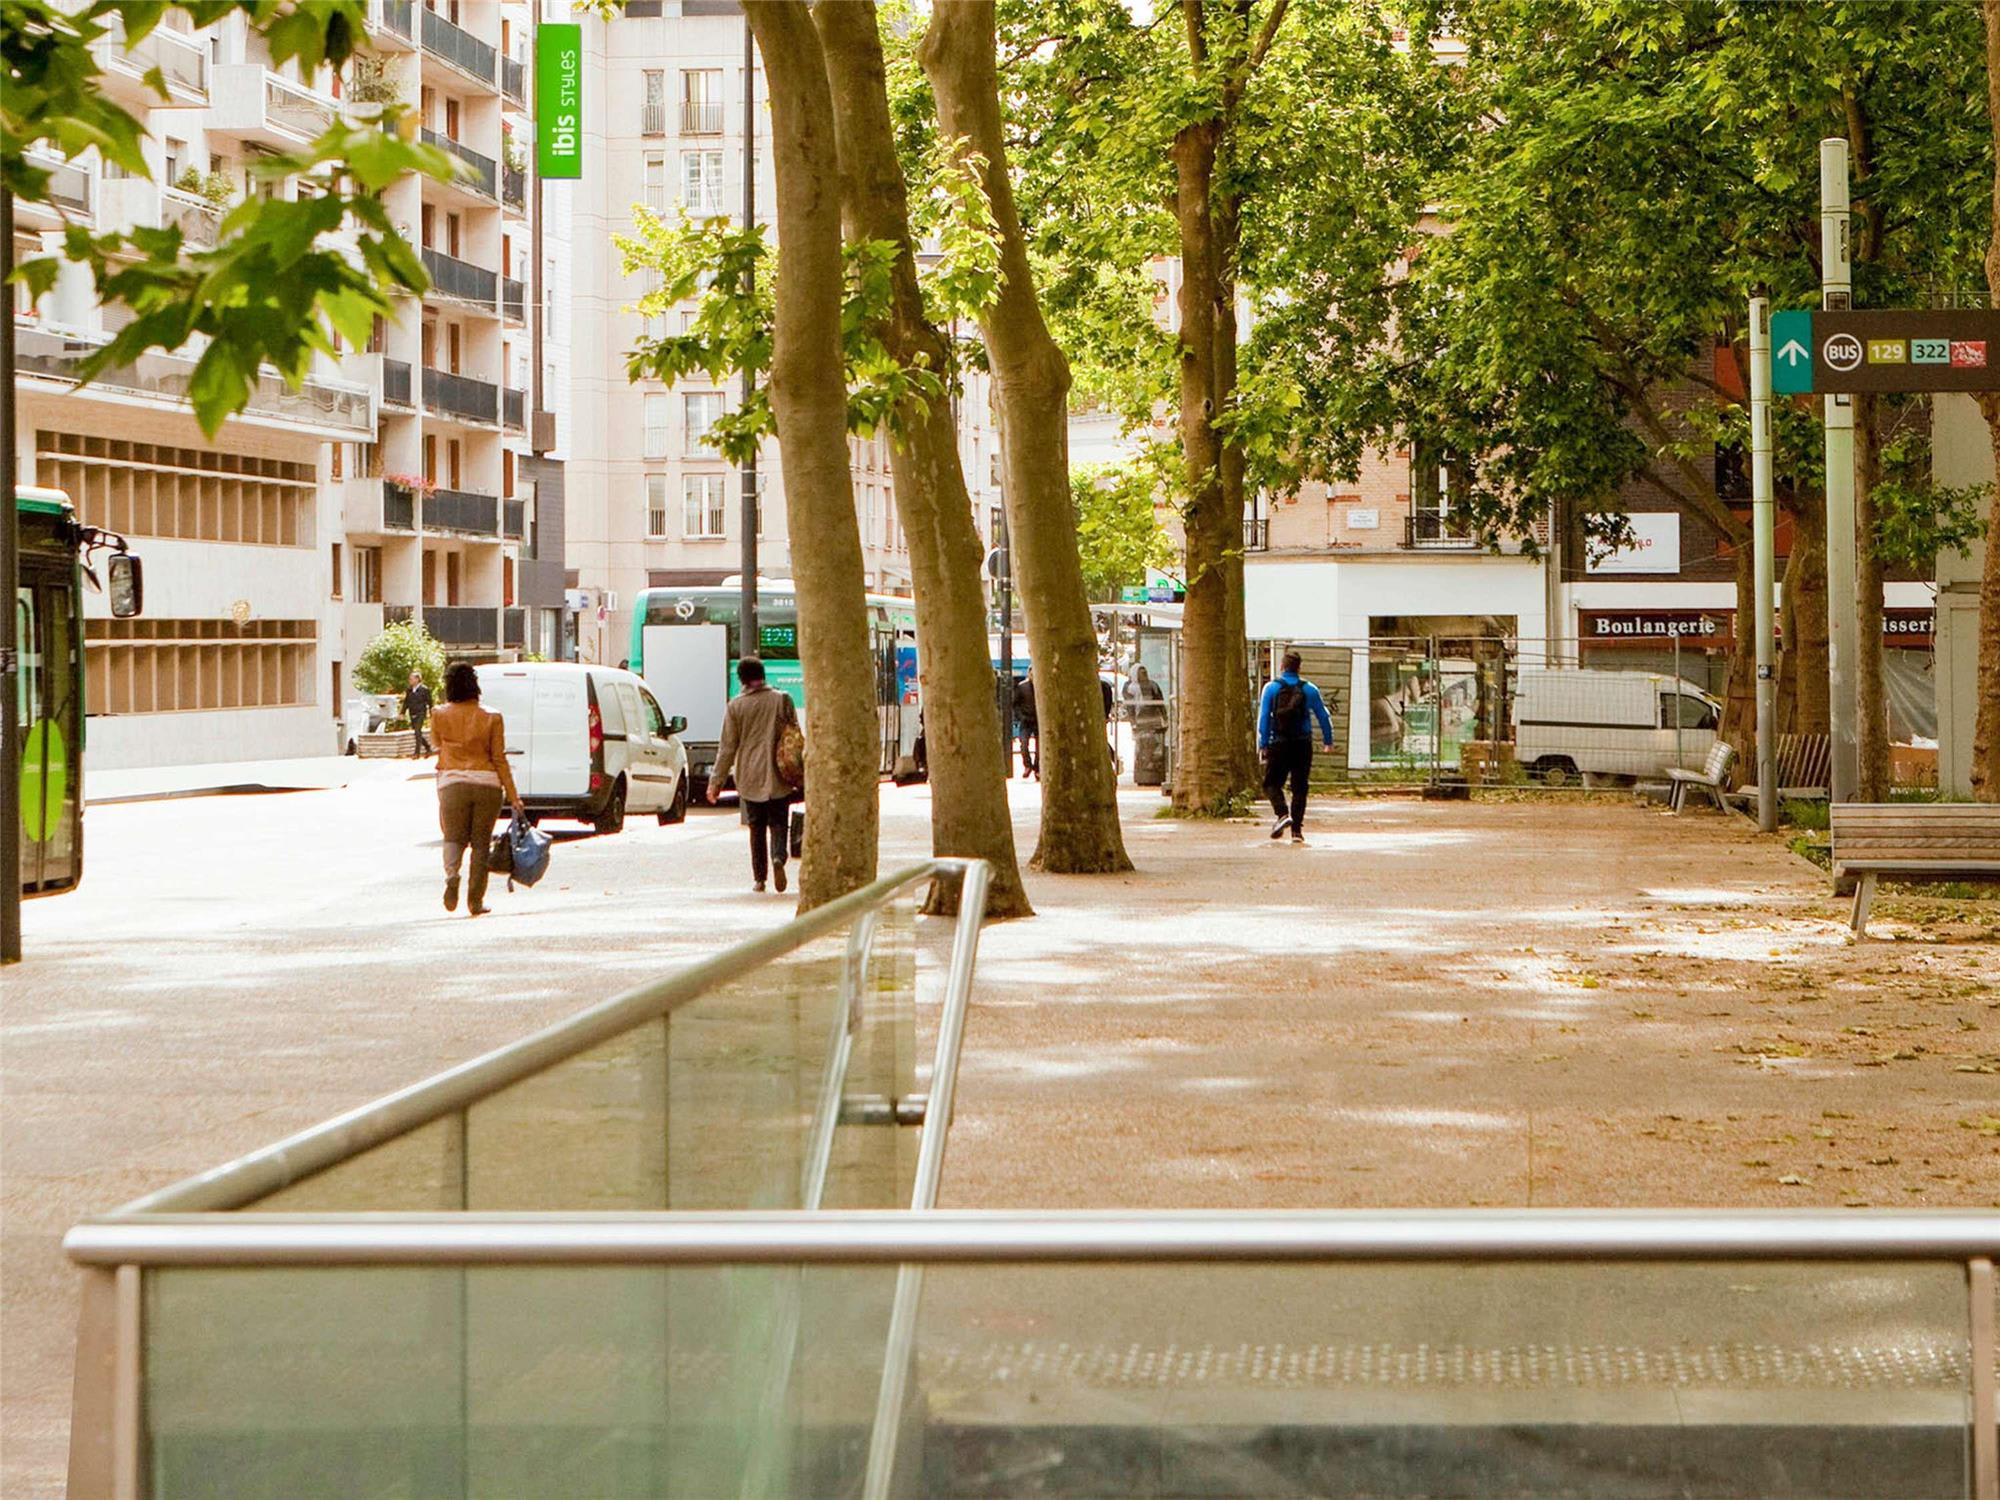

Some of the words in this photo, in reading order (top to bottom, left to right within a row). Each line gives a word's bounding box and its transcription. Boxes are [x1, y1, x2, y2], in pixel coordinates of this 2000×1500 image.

[552, 115, 576, 156] ibis
[1829, 344, 1858, 360] BUS
[1872, 344, 1904, 359] 129
[1915, 344, 1947, 359] 322
[1595, 616, 1716, 637] Boulangerie
[1882, 616, 1935, 632] isseri
